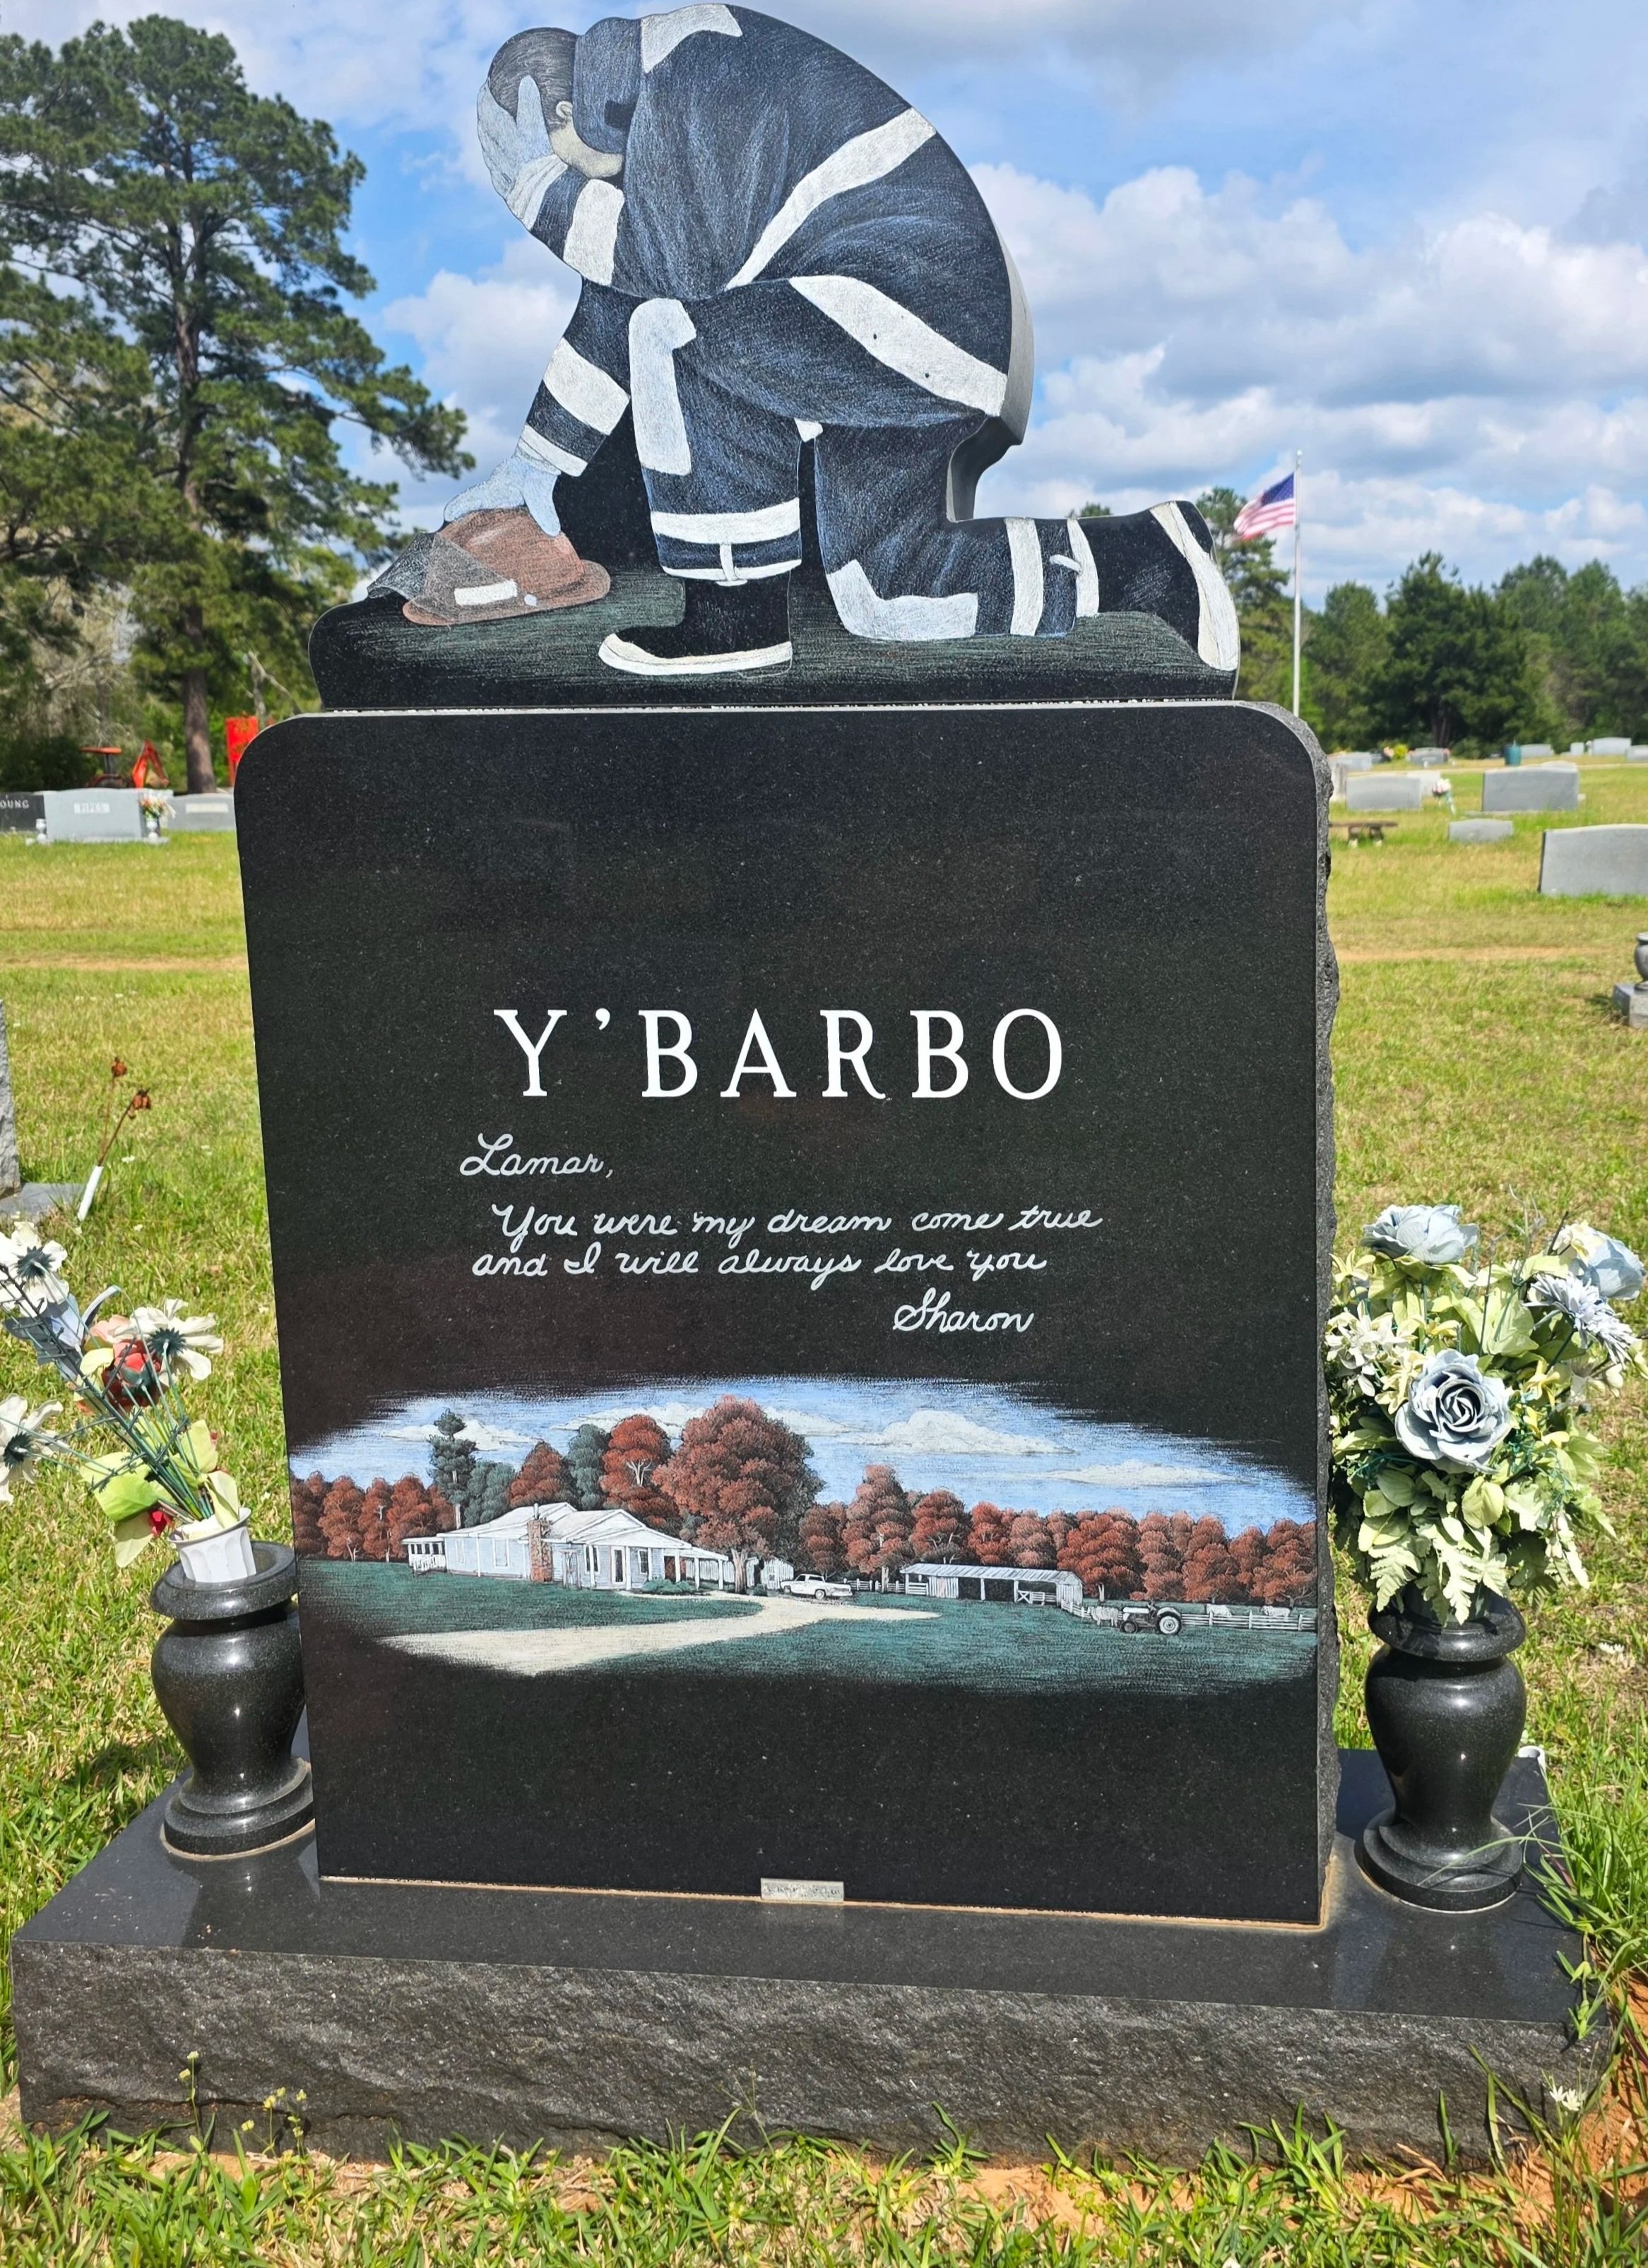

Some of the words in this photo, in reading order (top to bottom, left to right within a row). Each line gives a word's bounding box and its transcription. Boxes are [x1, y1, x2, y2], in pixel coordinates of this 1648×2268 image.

[494, 1008, 1062, 1100] Y'BARBO
[459, 1132, 613, 1178] Lamar,
[491, 1204, 578, 1254] You
[593, 1212, 678, 1235] were
[691, 1211, 756, 1249] my
[766, 1209, 892, 1234] dream
[911, 1212, 1004, 1231] come
[1007, 1204, 1103, 1231] true
[471, 1253, 548, 1277] and
[563, 1241, 602, 1275] I
[615, 1250, 699, 1275] will
[718, 1247, 862, 1291] always
[873, 1247, 954, 1274] love
[966, 1249, 1048, 1282] you
[892, 1287, 1035, 1334] Sharon
